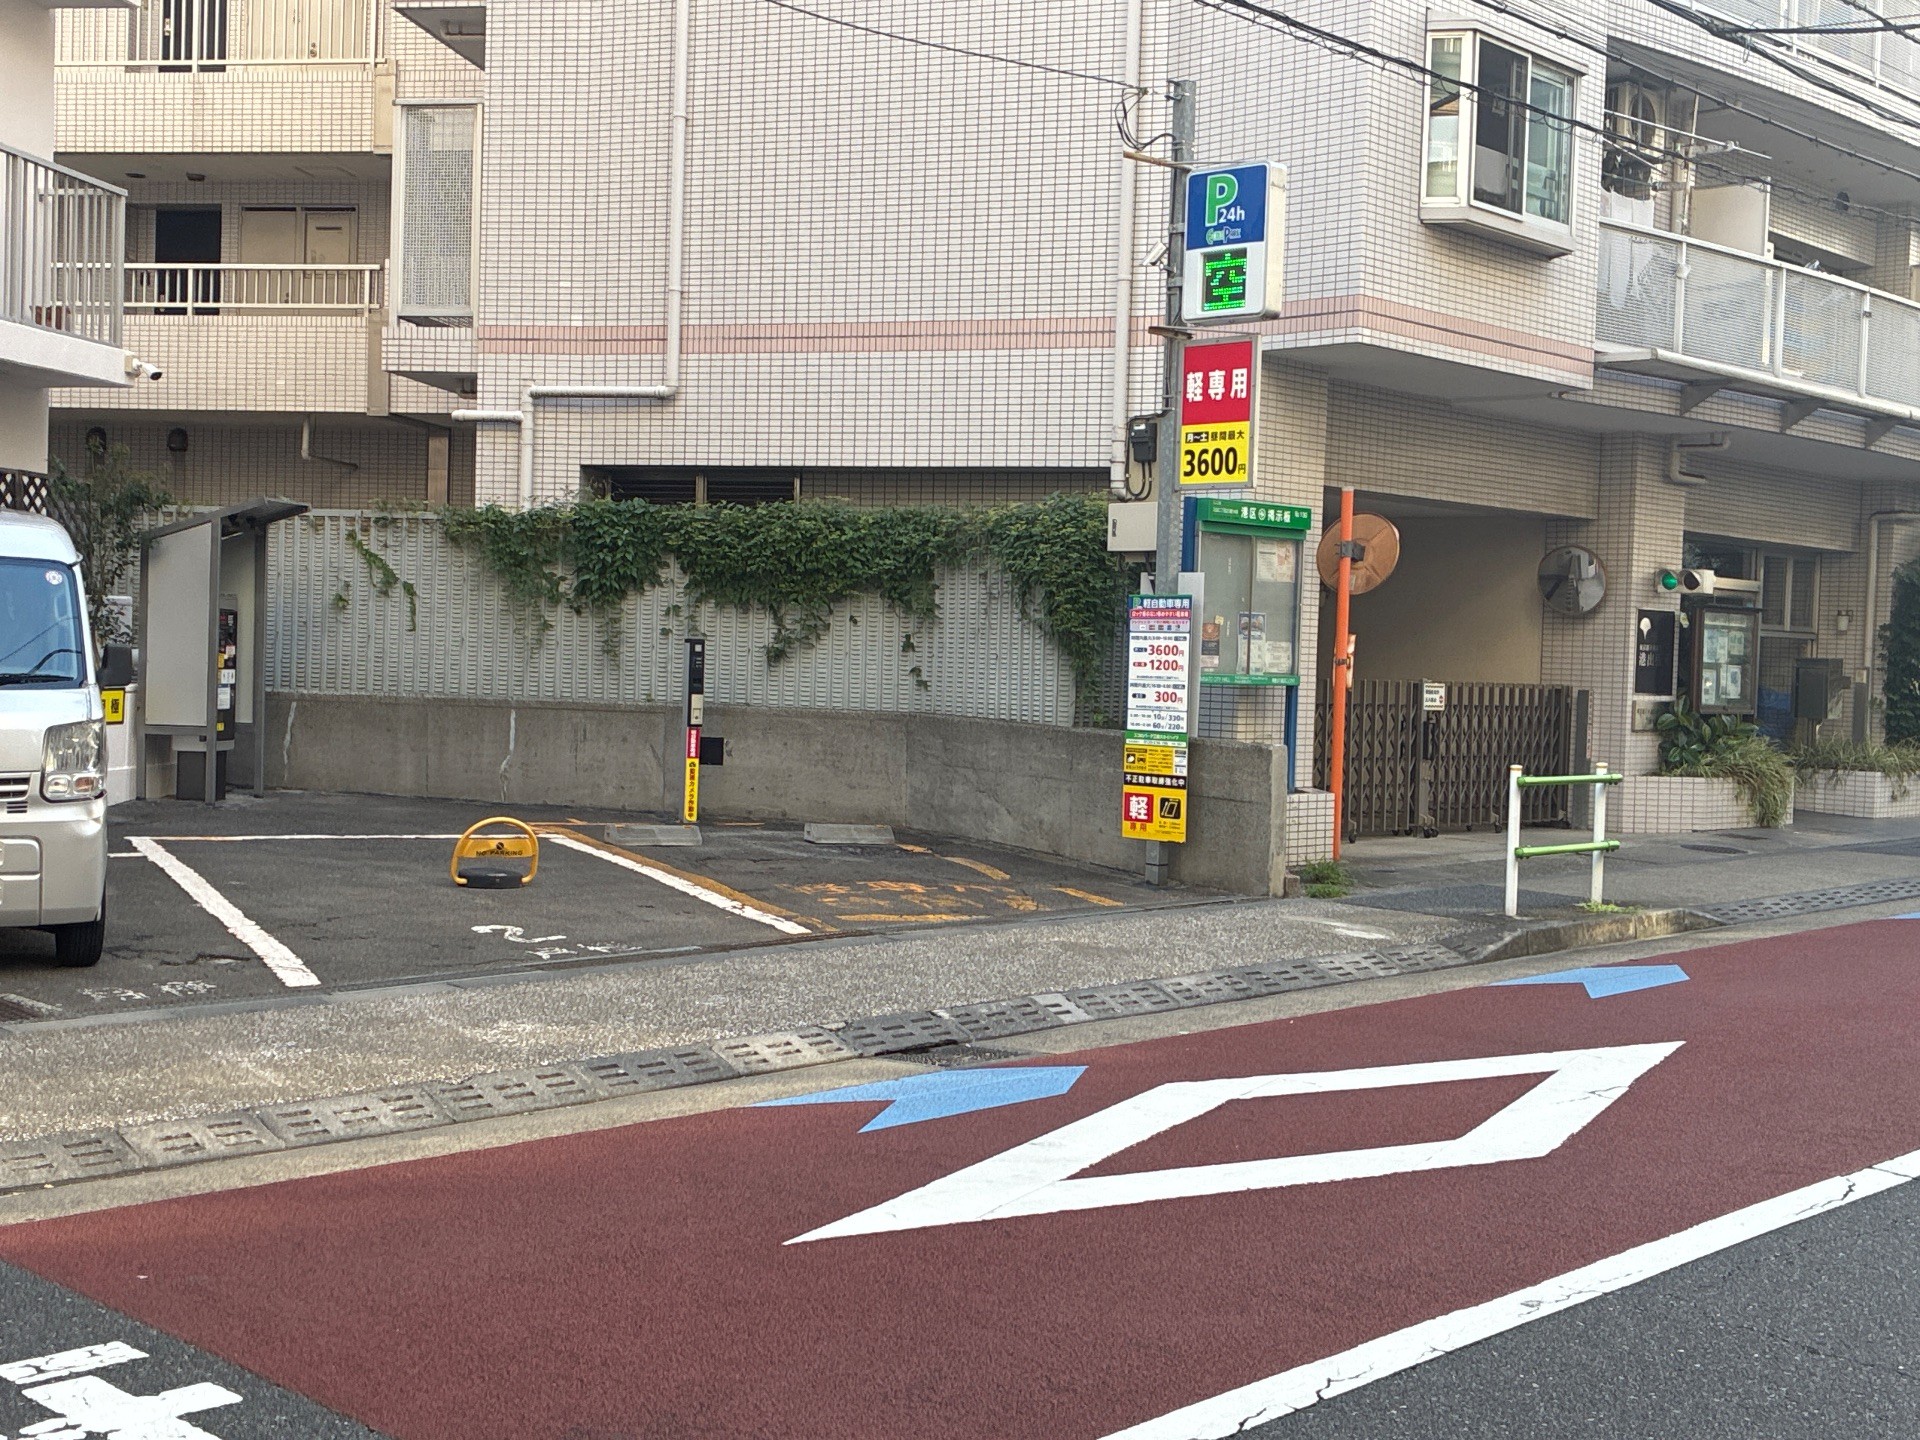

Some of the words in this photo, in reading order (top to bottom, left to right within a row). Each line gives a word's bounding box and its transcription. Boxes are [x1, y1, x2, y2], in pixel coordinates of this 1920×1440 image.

[1205, 174, 1238, 226] P
[1219, 206, 1245, 223] 24h
[1204, 253, 1246, 310] 空
[1186, 367, 1248, 402] 軽専用
[1210, 429, 1245, 442] 昼間最大
[1143, 598, 1190, 609] 軽自動車専用
[1129, 795, 1148, 820] 軽
[489, 849, 525, 857] PARKING
